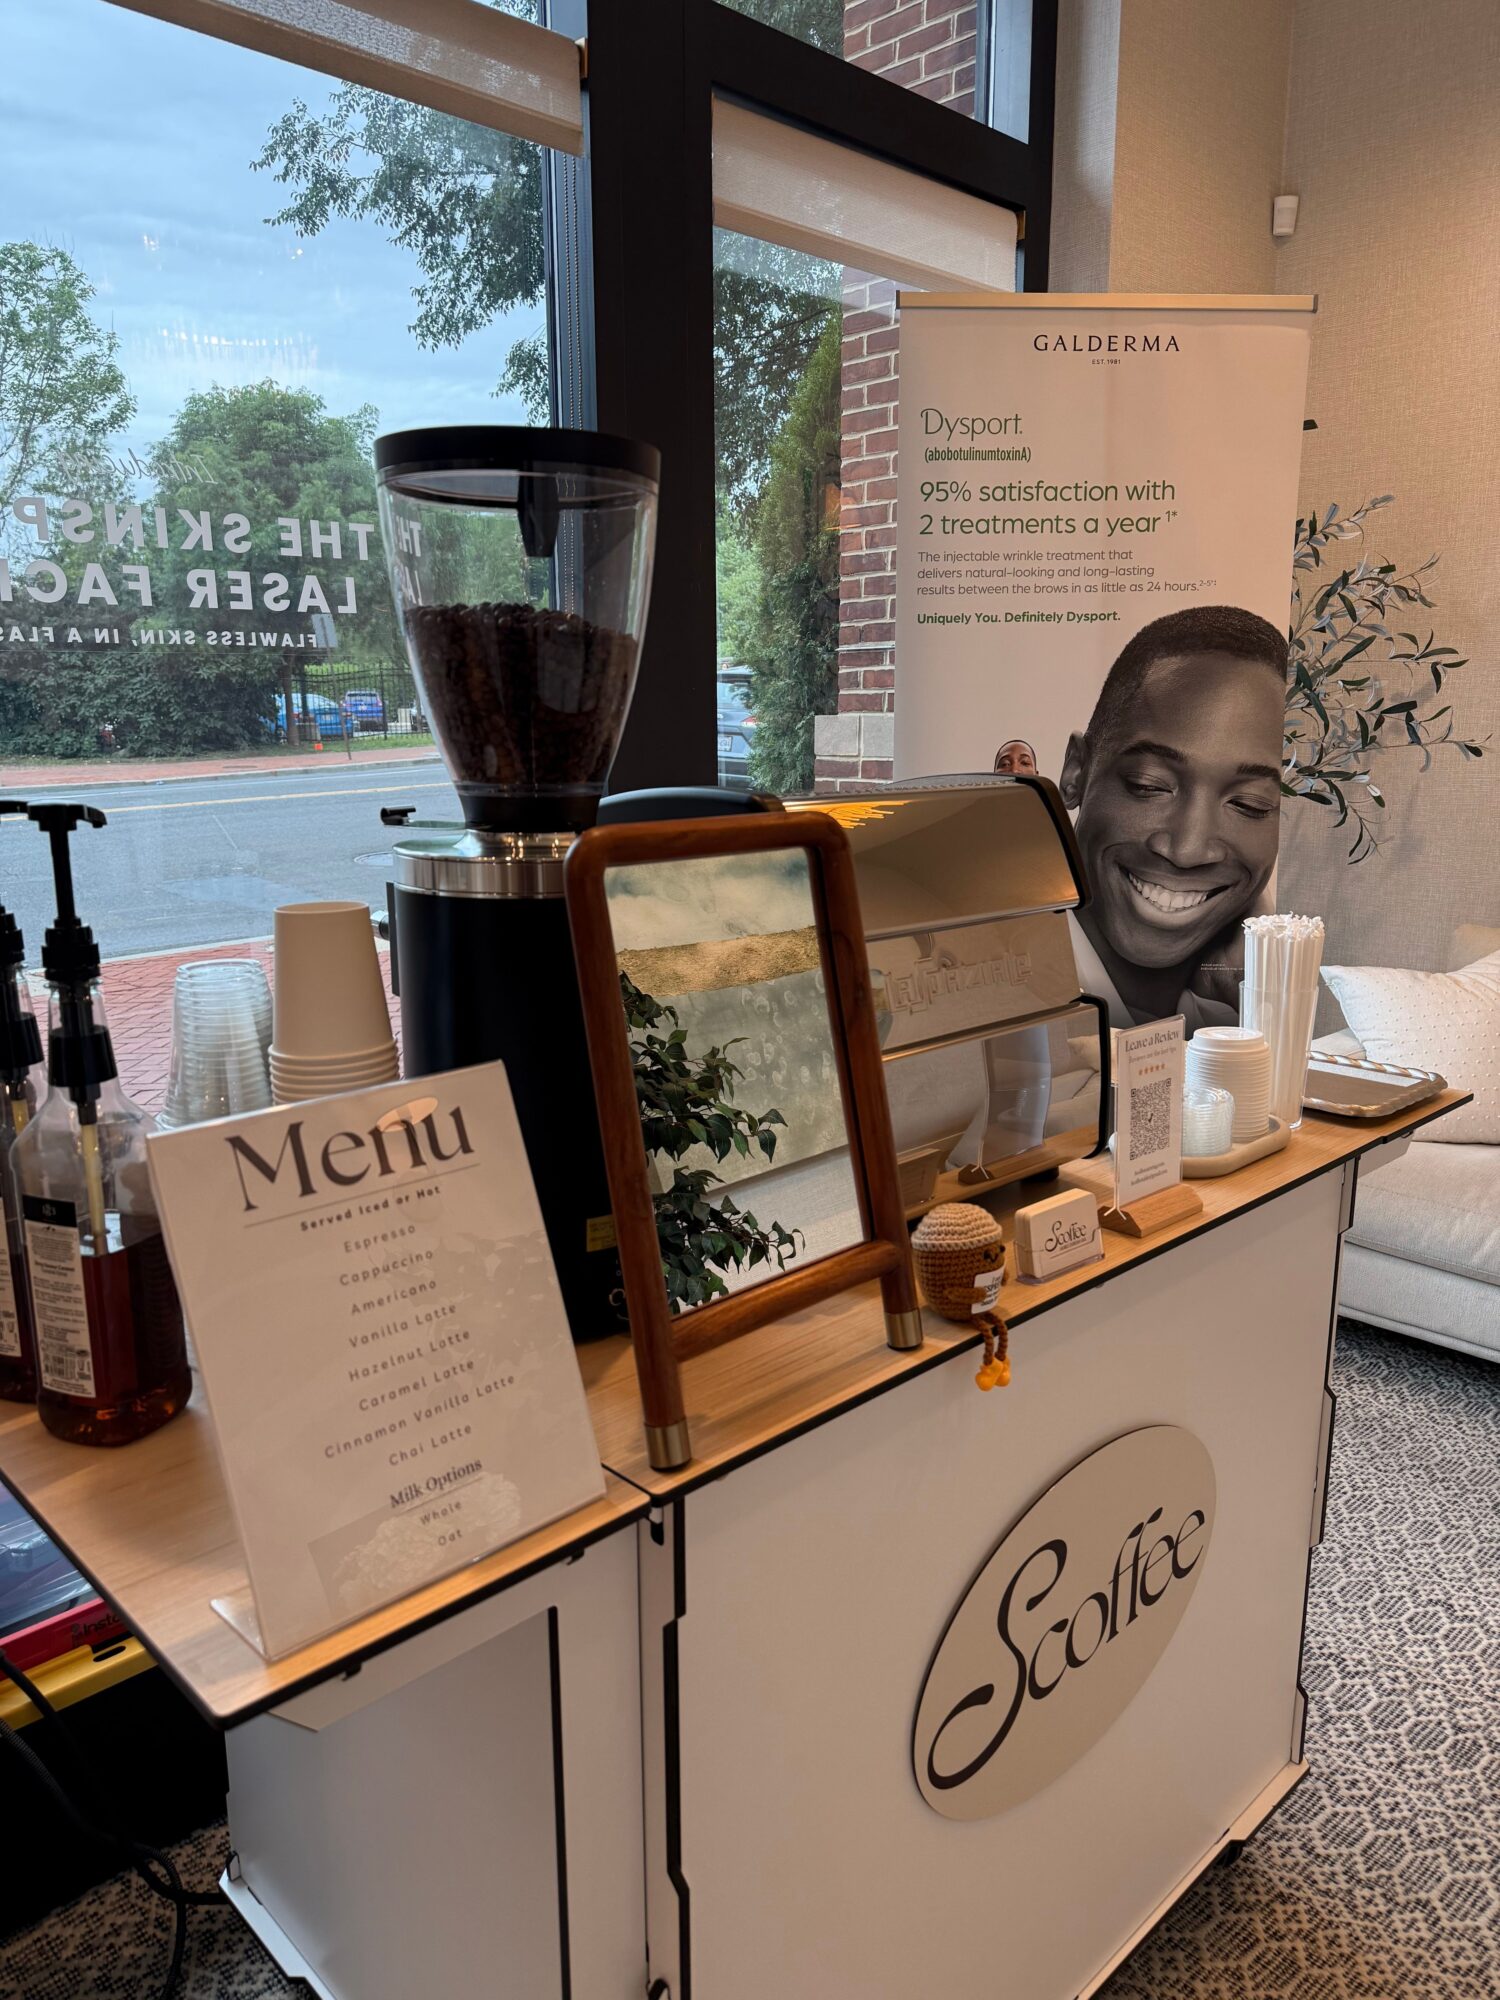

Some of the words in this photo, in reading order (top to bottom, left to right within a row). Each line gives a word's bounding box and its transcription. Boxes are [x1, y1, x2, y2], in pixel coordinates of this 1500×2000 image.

[1033, 334, 1180, 352] GALDERMA
[924, 446, 1031, 463] (abobotulinumtoxinA)
[920, 481, 972, 502] 95%
[979, 480, 1118, 501] satisfaction
[1125, 480, 1175, 500] with
[919, 514, 934, 535] 2
[941, 513, 1077, 535] treatments
[1083, 517, 1099, 533] a
[1107, 516, 1161, 537] year
[918, 551, 940, 563] The
[943, 550, 1000, 564] injectable
[1003, 550, 1043, 561] wrinkle
[1046, 550, 1106, 561] treatment
[1108, 549, 1133, 561] that
[917, 567, 963, 579] delivers
[965, 566, 1055, 580] natural-looking
[1057, 566, 1081, 577] and
[1083, 565, 1155, 579] long-lasting
[917, 584, 955, 596] results
[958, 583, 1009, 595] between
[1011, 583, 1032, 595] the
[1033, 583, 1069, 594] brows
[1071, 582, 1082, 593] in
[1084, 584, 1098, 593] as
[1101, 581, 1127, 593] little
[1129, 583, 1144, 592] as
[1147, 581, 1161, 592] 24
[917, 611, 972, 626] Uniquely
[975, 611, 1001, 624] You.
[1004, 610, 1064, 624] Definitely
[1066, 609, 1121, 625] Dysport.
[1125, 1038, 1148, 1052] Leave
[1148, 1036, 1153, 1046] a
[1154, 1030, 1179, 1045] Review
[224, 1106, 475, 1212] Menu
[300, 1209, 352, 1232] Served
[359, 1199, 389, 1215] Iced
[396, 1193, 410, 1206] or
[417, 1185, 441, 1200] Hot
[343, 1223, 416, 1253] Espresso
[1044, 1220, 1087, 1252] Scoffee
[339, 1249, 434, 1287] Cappuccino
[351, 1278, 437, 1315] Americano
[348, 1321, 409, 1348] Vanilla
[415, 1304, 456, 1326] Latte
[348, 1347, 424, 1382] Hazelnut
[429, 1330, 471, 1352] Latte
[358, 1376, 427, 1411] Caramel
[433, 1359, 475, 1383] Latte
[324, 1418, 407, 1459] Cinnamon
[413, 1393, 470, 1422] Vanilla
[475, 1374, 515, 1398] Latte
[388, 1445, 424, 1466] Chai
[430, 1423, 472, 1448] Latte
[388, 1483, 424, 1509] Milk
[426, 1458, 483, 1491] Options
[420, 1500, 462, 1525] Whole
[437, 1529, 463, 1546] Oat
[926, 1506, 1206, 1790] Scoffee
